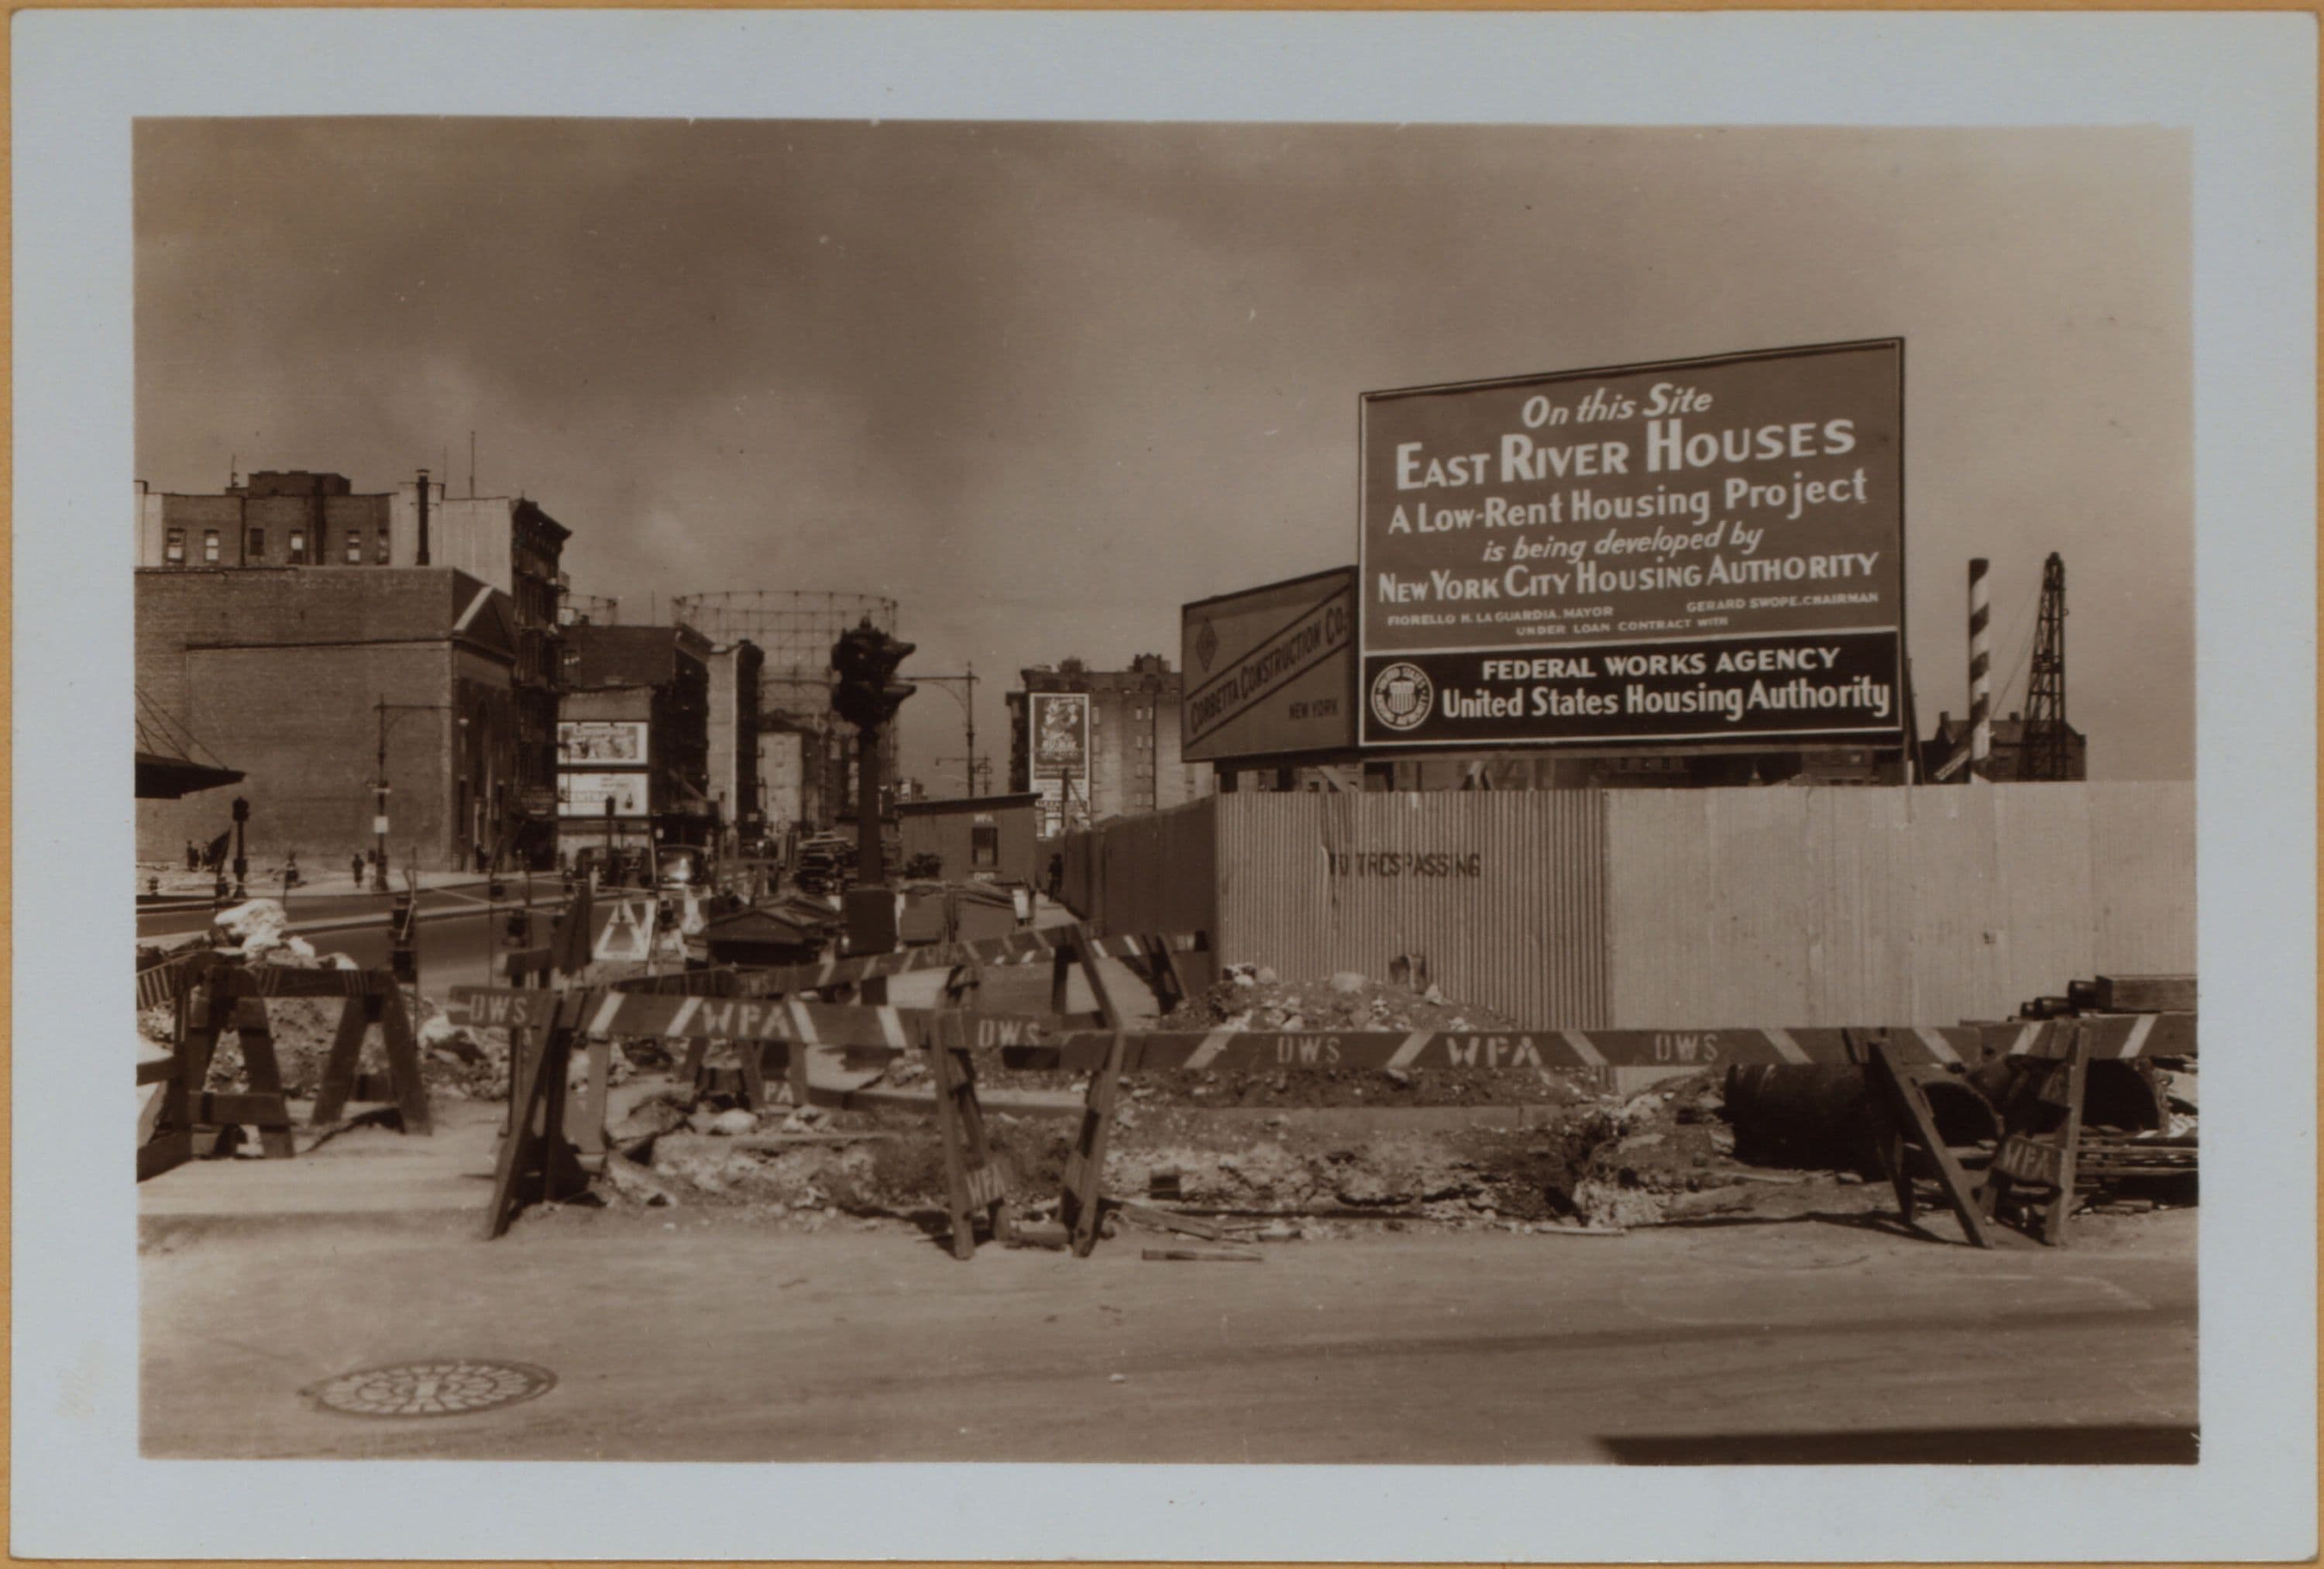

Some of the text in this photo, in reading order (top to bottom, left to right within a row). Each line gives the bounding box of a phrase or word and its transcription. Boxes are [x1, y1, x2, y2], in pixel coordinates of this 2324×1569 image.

[1522, 383, 1712, 428] On this Site
[1397, 417, 1855, 490] EAST RIVER HOUSES
[1389, 468, 1867, 533] A Low-Rent Housing Project
[1483, 521, 1763, 566] is being developed by
[1379, 573, 1428, 602] NEW
[1432, 570, 1500, 600] YORK
[1504, 566, 1570, 597] CITY
[1708, 552, 1878, 584] AUTHORITY
[1517, 625, 1565, 635] UNDER
[1573, 624, 1610, 633] LOAN
[1618, 620, 1690, 631] CONTRACT
[1563, 606, 1613, 618] MAYOR
[1686, 598, 1745, 612] GERARD
[1190, 676, 1240, 735] CORBETTA
[1241, 619, 1322, 700] CONSTRUCTION
[1483, 648, 1839, 680] FEDERAL WORKS AGENCY
[1443, 688, 1523, 717] United
[1532, 686, 1618, 716] States
[1627, 683, 1743, 721] Housing
[1747, 676, 1889, 717] Authority
[702, 1001, 792, 1037] WPA
[1446, 1036, 1543, 1067] WPA
